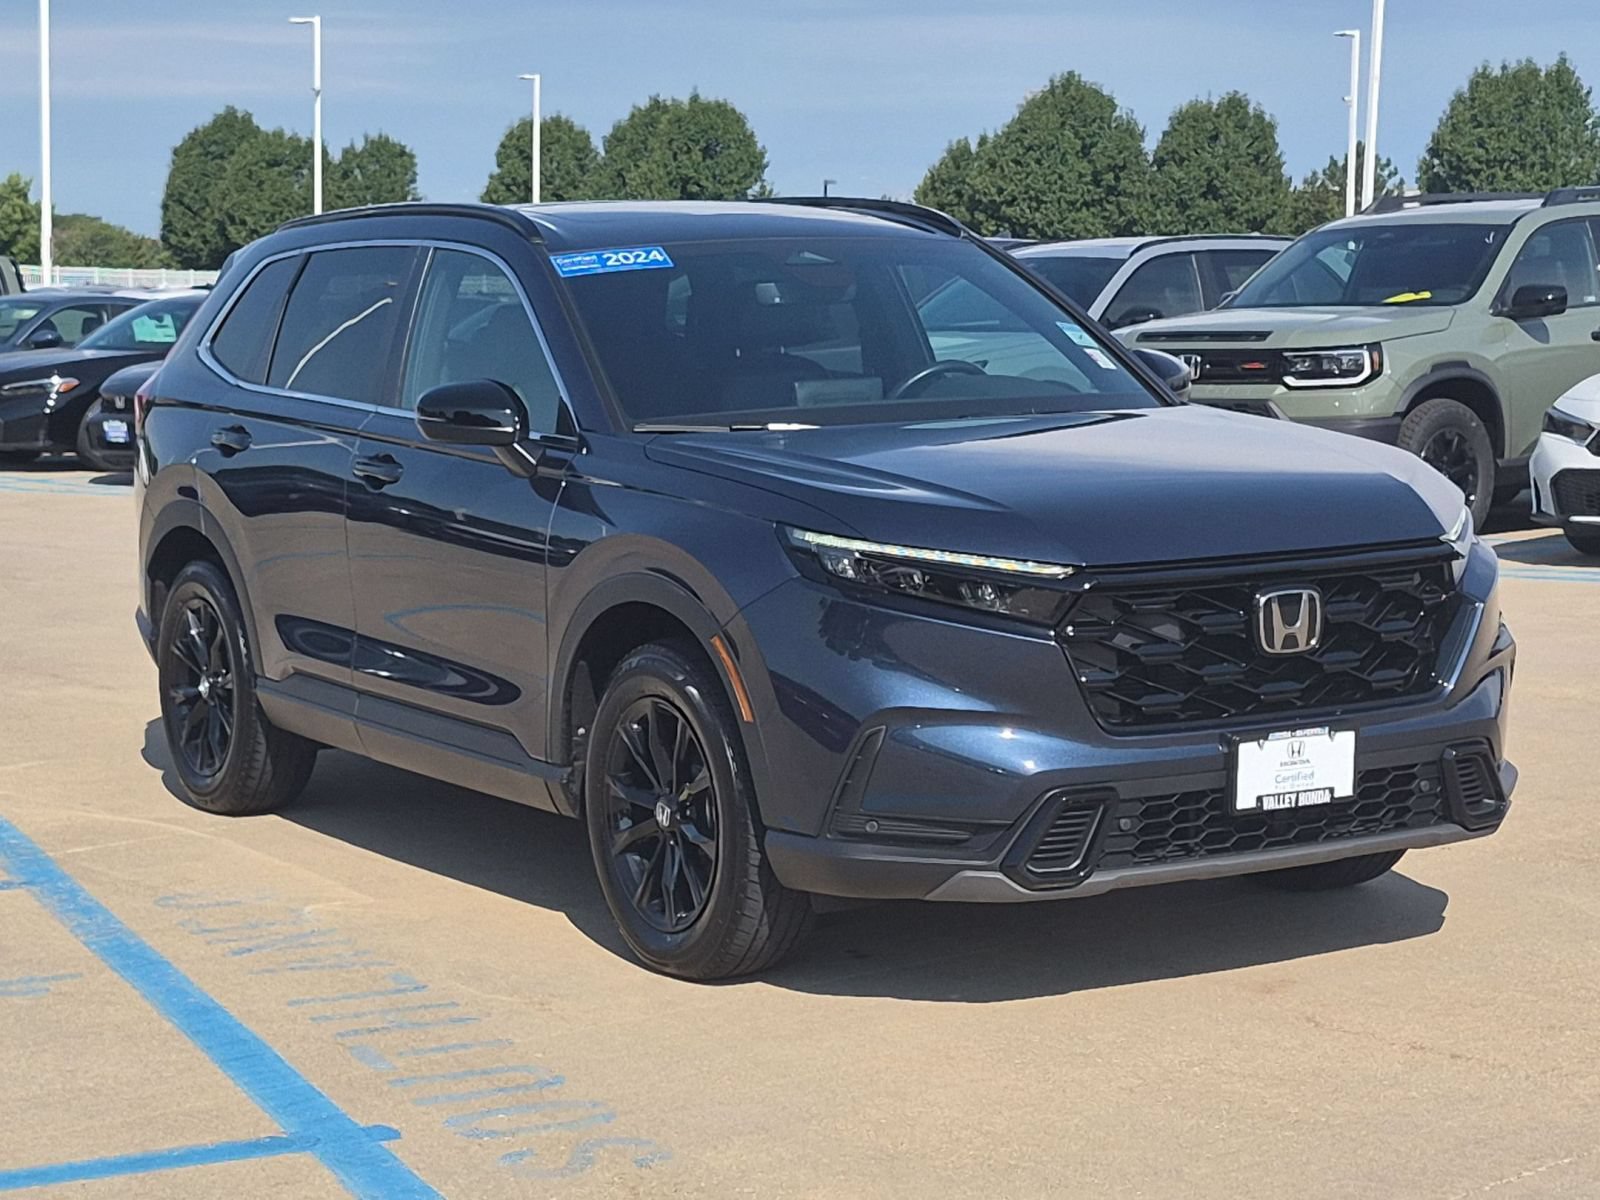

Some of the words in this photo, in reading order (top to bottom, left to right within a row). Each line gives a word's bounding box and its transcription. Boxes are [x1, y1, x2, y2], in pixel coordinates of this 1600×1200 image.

[602, 249, 664, 266] 2024
[1274, 770, 1315, 785] Certified
[1263, 793, 1298, 811] VALLEY
[1298, 789, 1331, 807] HONDA
